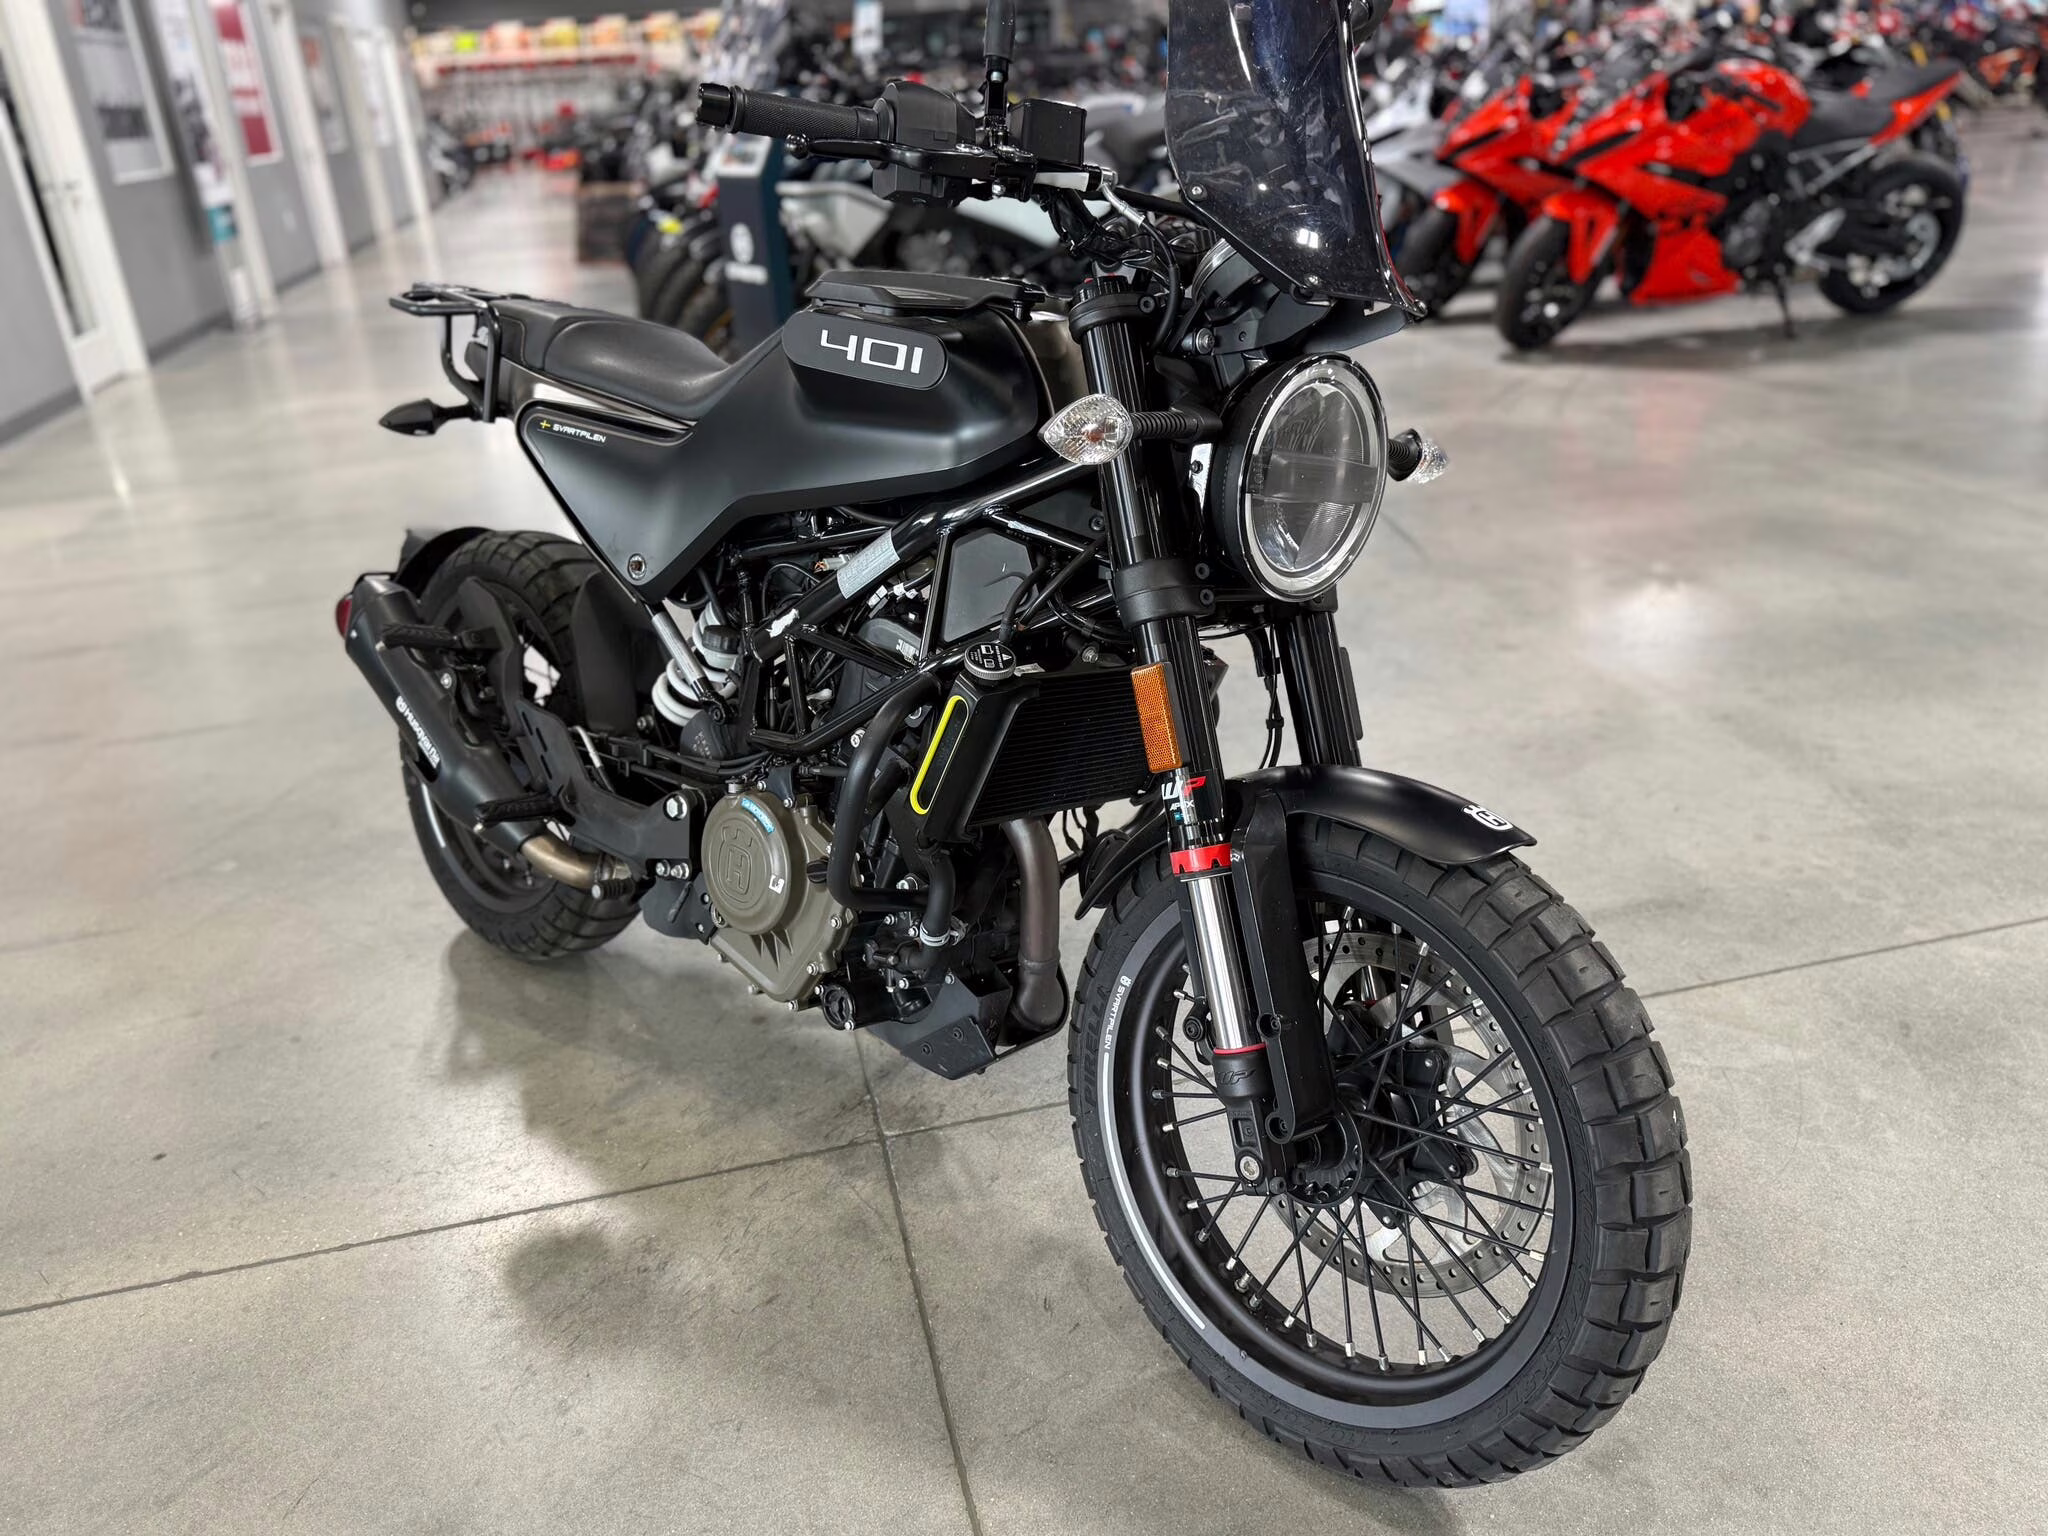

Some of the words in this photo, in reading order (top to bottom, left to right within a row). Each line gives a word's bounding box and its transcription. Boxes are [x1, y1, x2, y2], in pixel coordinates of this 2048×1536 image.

[820, 329, 924, 374] 401
[552, 423, 607, 443] SVARTPILEN
[1161, 775, 1207, 800] WP
[1169, 799, 1196, 812] APX
[1104, 985, 1126, 1050] SVARTPILEN
